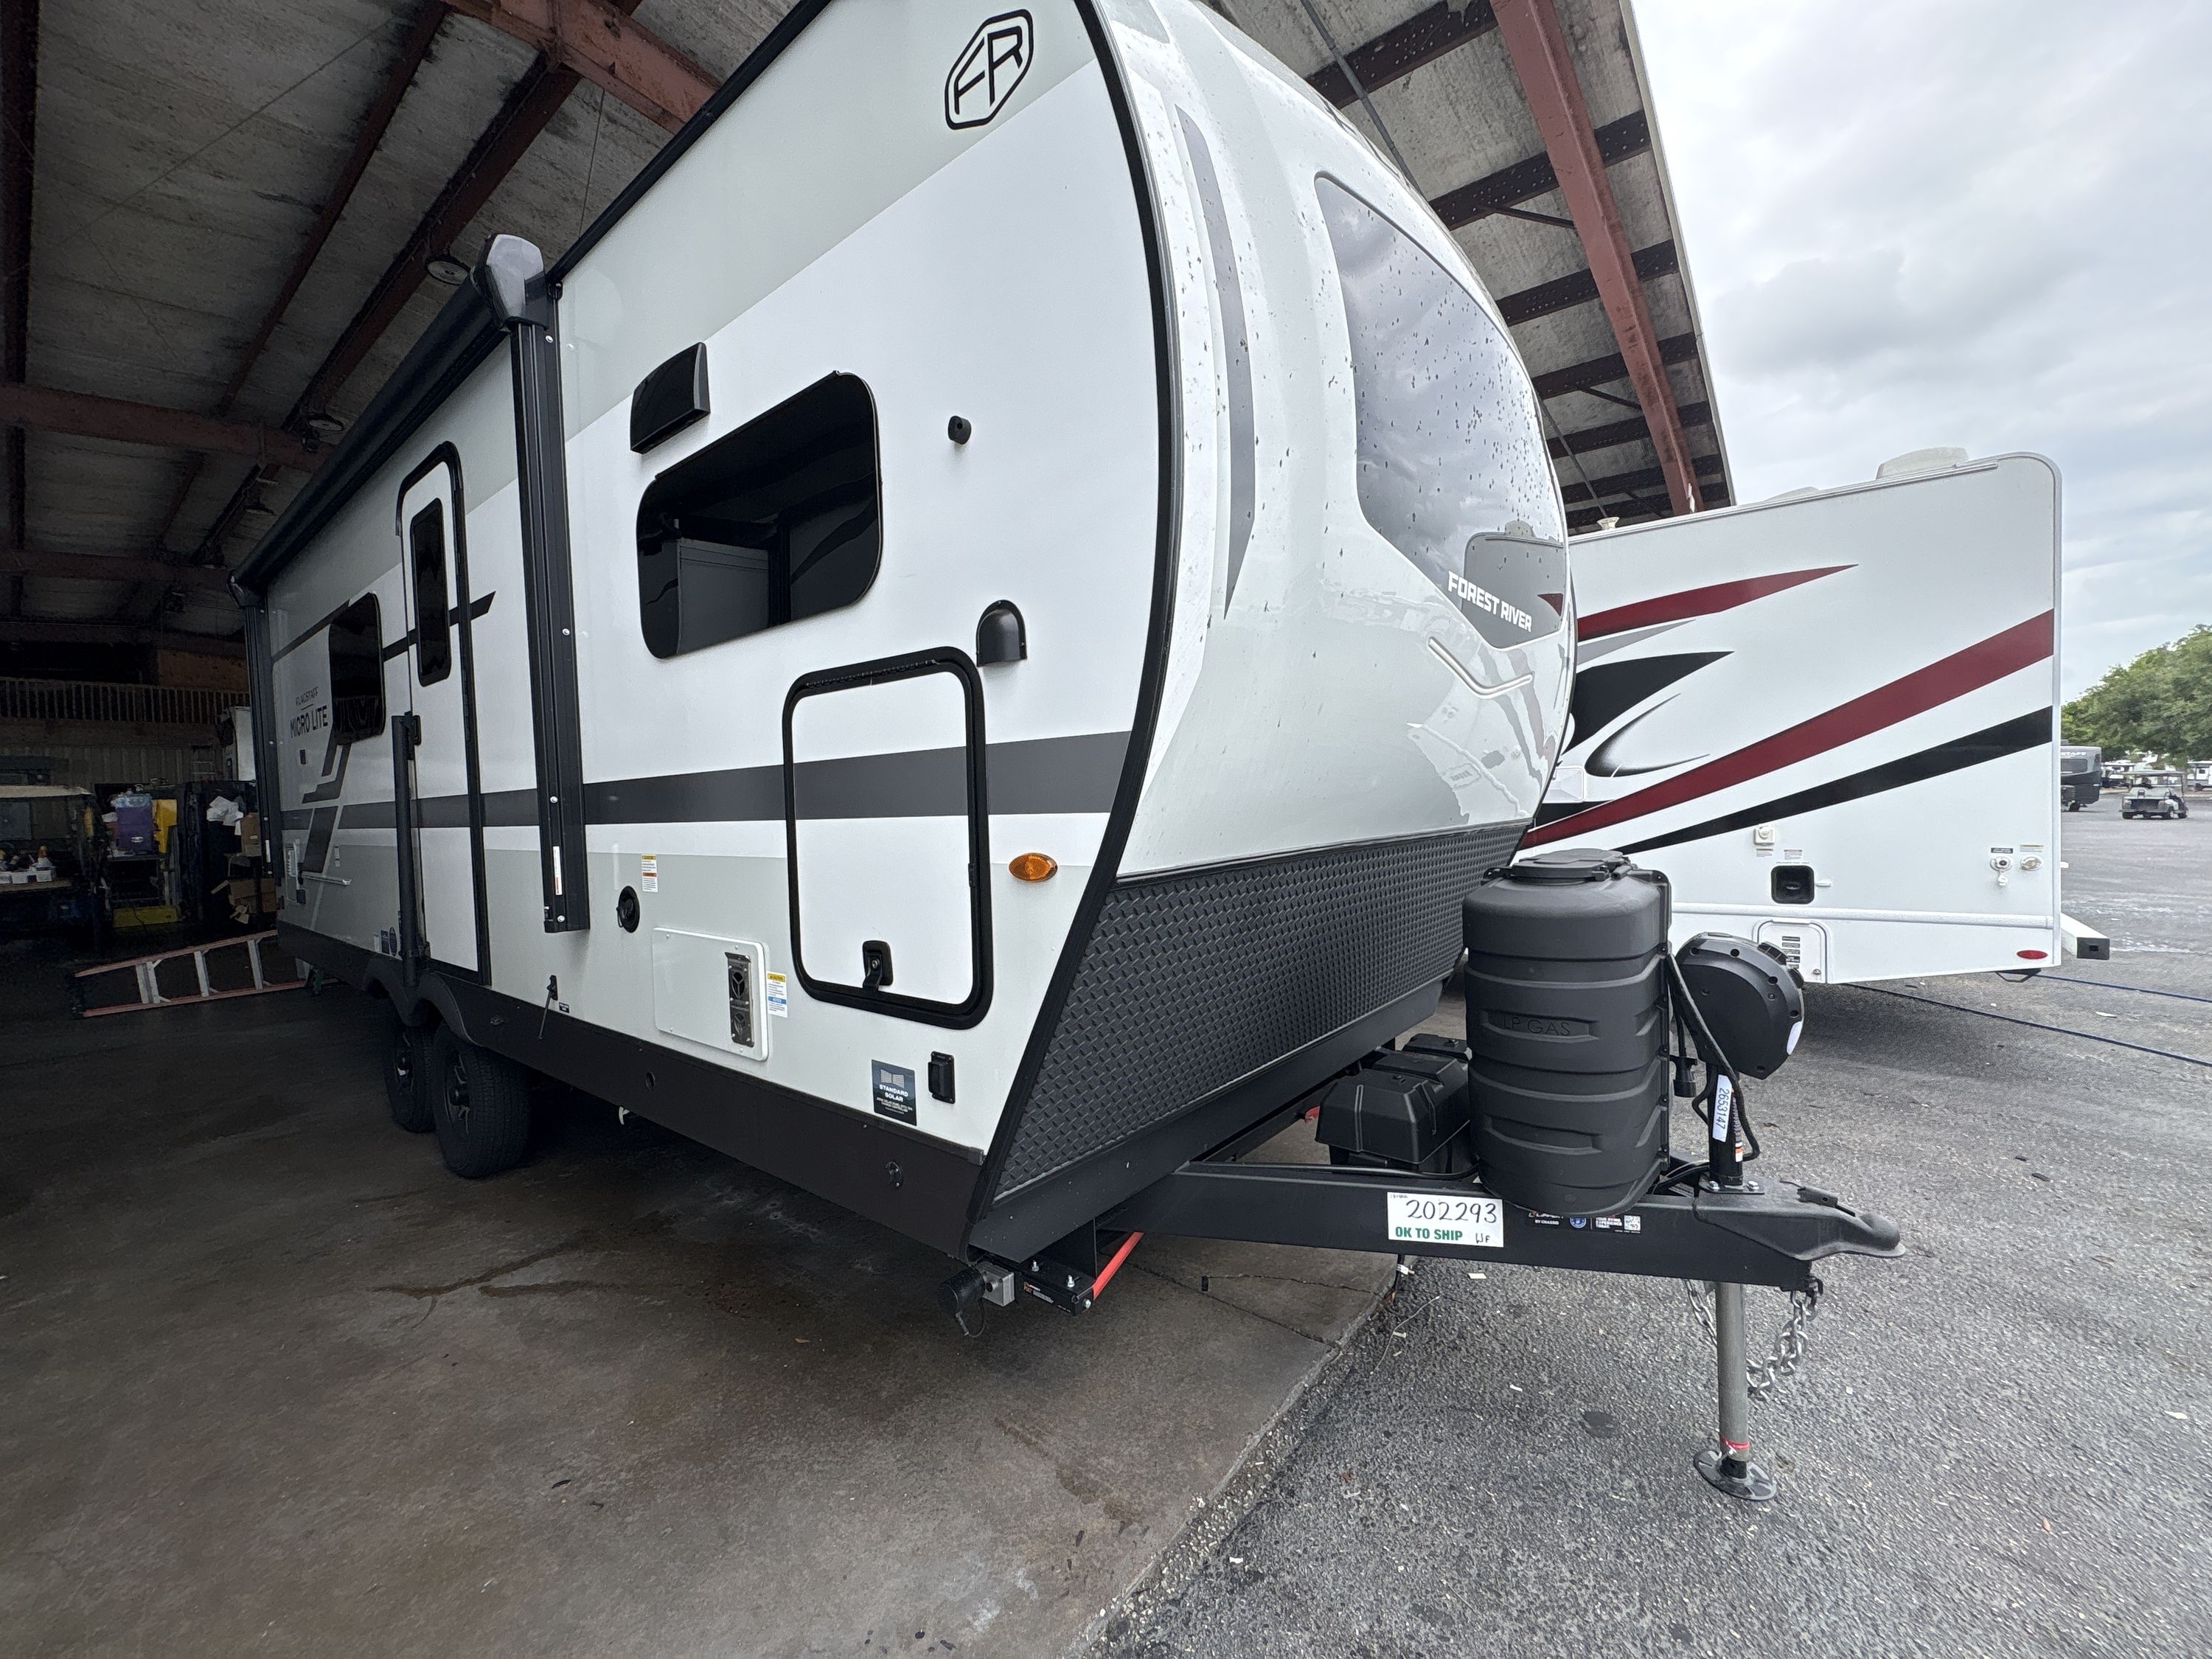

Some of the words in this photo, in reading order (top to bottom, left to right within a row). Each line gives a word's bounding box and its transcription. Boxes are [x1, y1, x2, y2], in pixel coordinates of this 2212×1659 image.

[1447, 570, 1500, 615] FOREST
[1500, 600, 1532, 633] RIVER
[291, 712, 310, 739] MICRO
[311, 705, 328, 731] LITE
[1527, 1019, 1571, 1037] GAS
[879, 1084, 908, 1097] STANDARD
[885, 1092, 903, 1102] SOLAR
[1715, 1088, 1730, 1130] 2653147
[1405, 1199, 1498, 1223] 202293
[1395, 1226, 1412, 1238] OK
[1415, 1228, 1430, 1239] TO
[1433, 1229, 1463, 1241] SHIP
